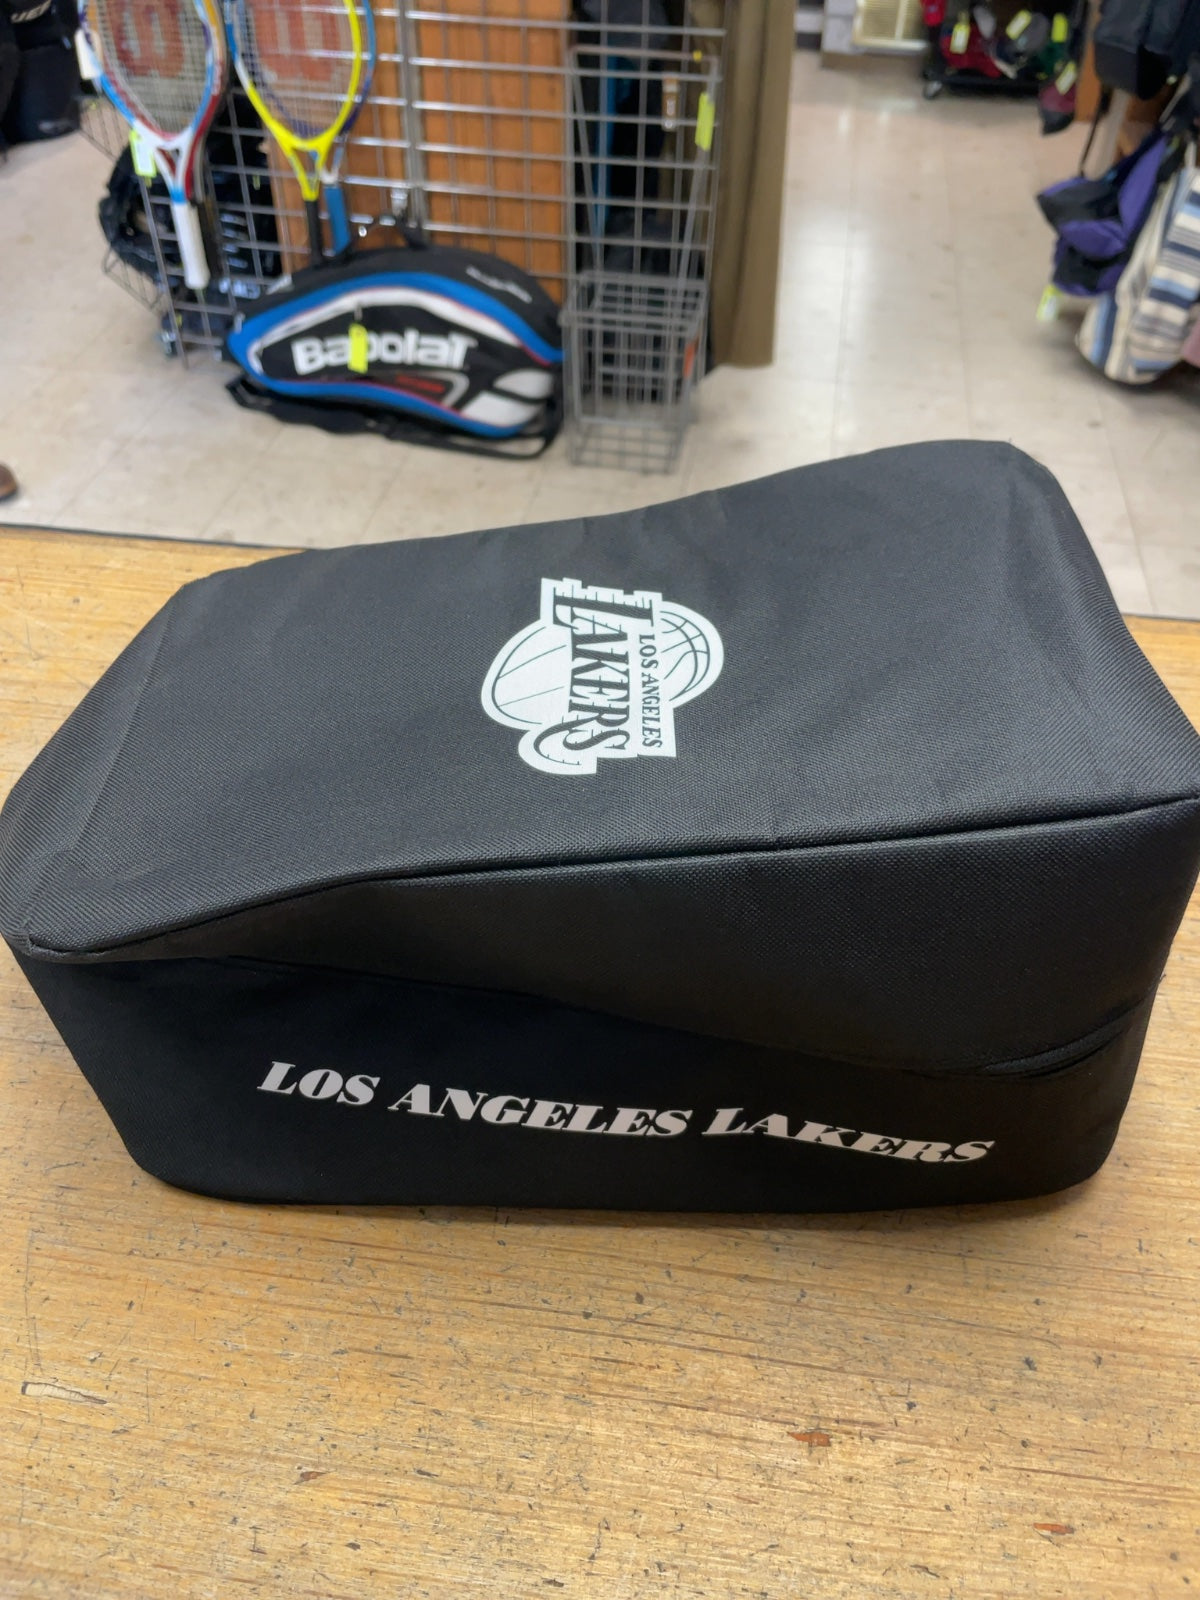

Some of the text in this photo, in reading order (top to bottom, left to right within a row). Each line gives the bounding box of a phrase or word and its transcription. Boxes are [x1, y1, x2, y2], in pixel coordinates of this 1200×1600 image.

[533, 585, 654, 766] LAKERS
[639, 634, 663, 748] LOS ANGELES
[257, 1061, 995, 1163] LOS ANGELES LAKERS
